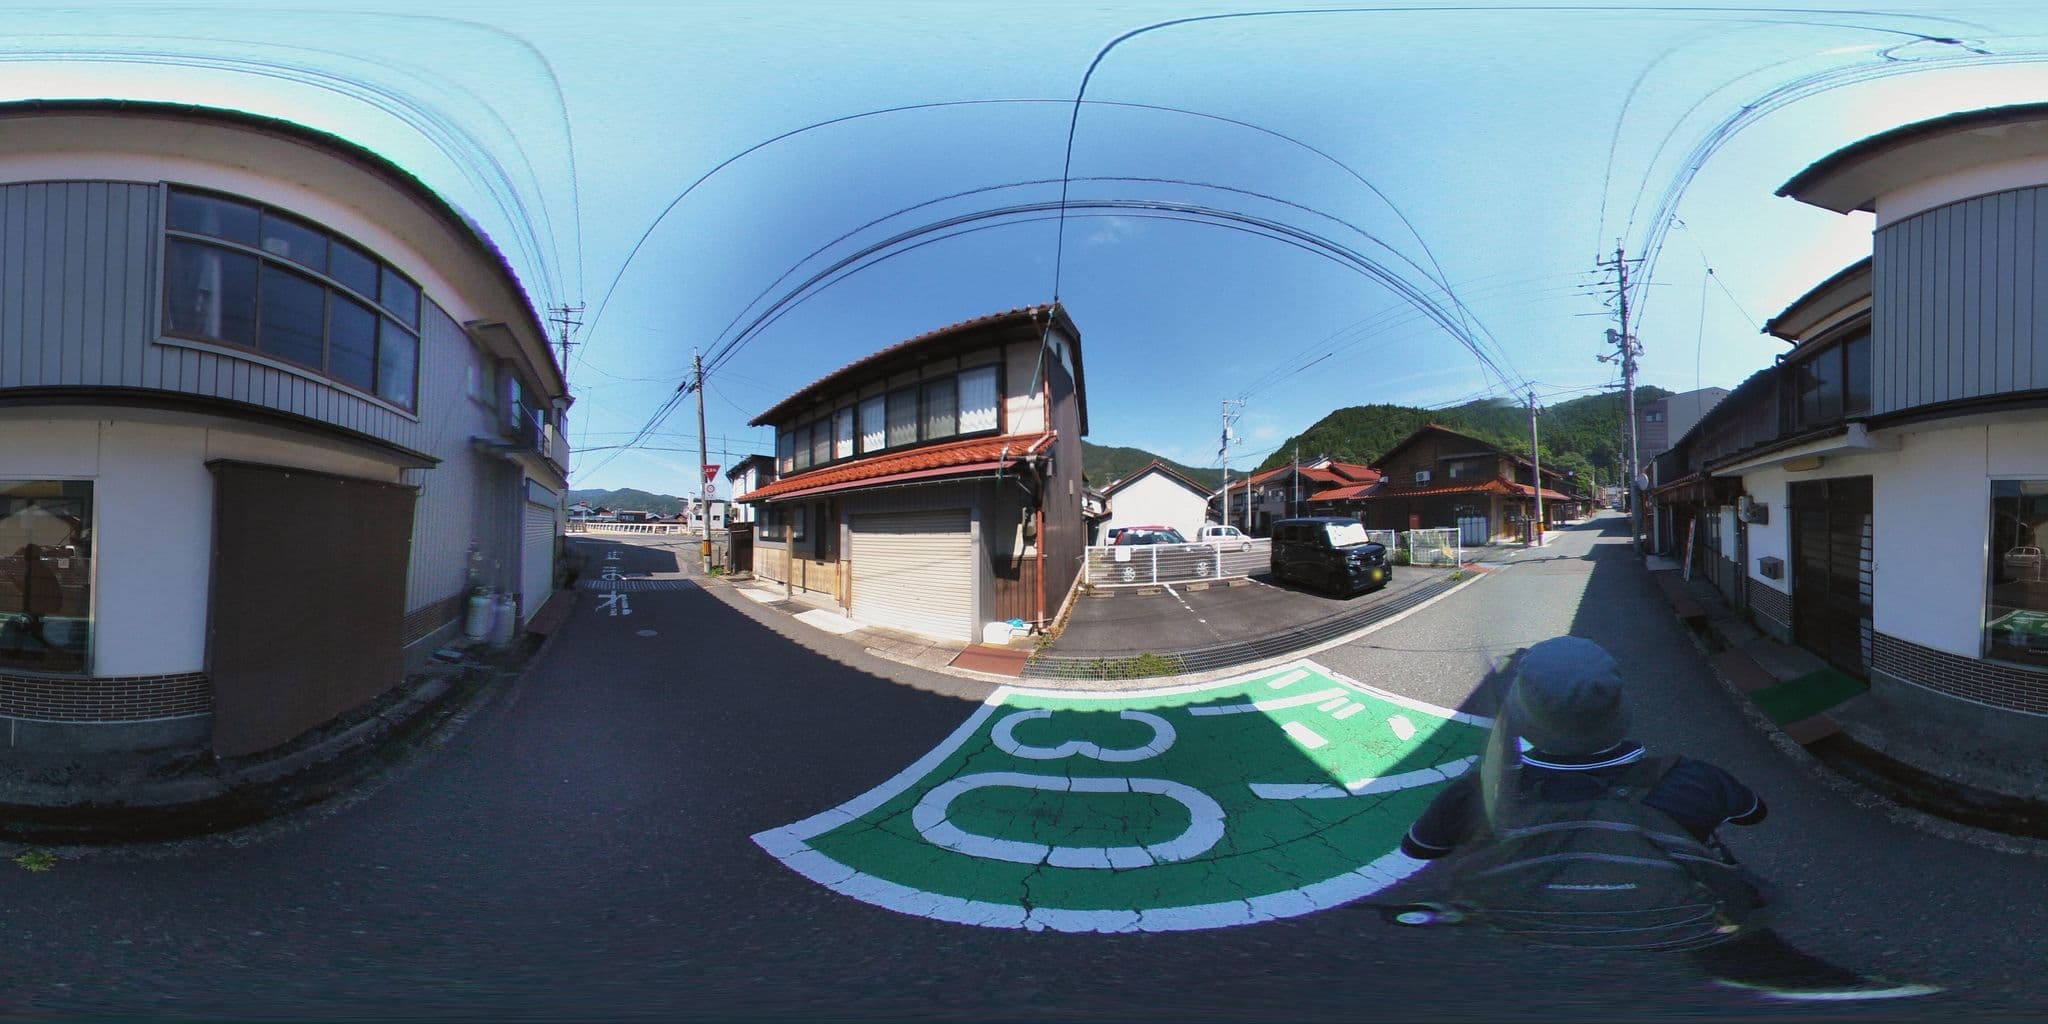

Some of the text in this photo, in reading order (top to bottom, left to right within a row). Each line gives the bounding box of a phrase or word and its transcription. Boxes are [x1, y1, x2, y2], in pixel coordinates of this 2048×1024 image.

[595, 550, 632, 616] 止まれ
[911, 708, 1227, 869] 30
